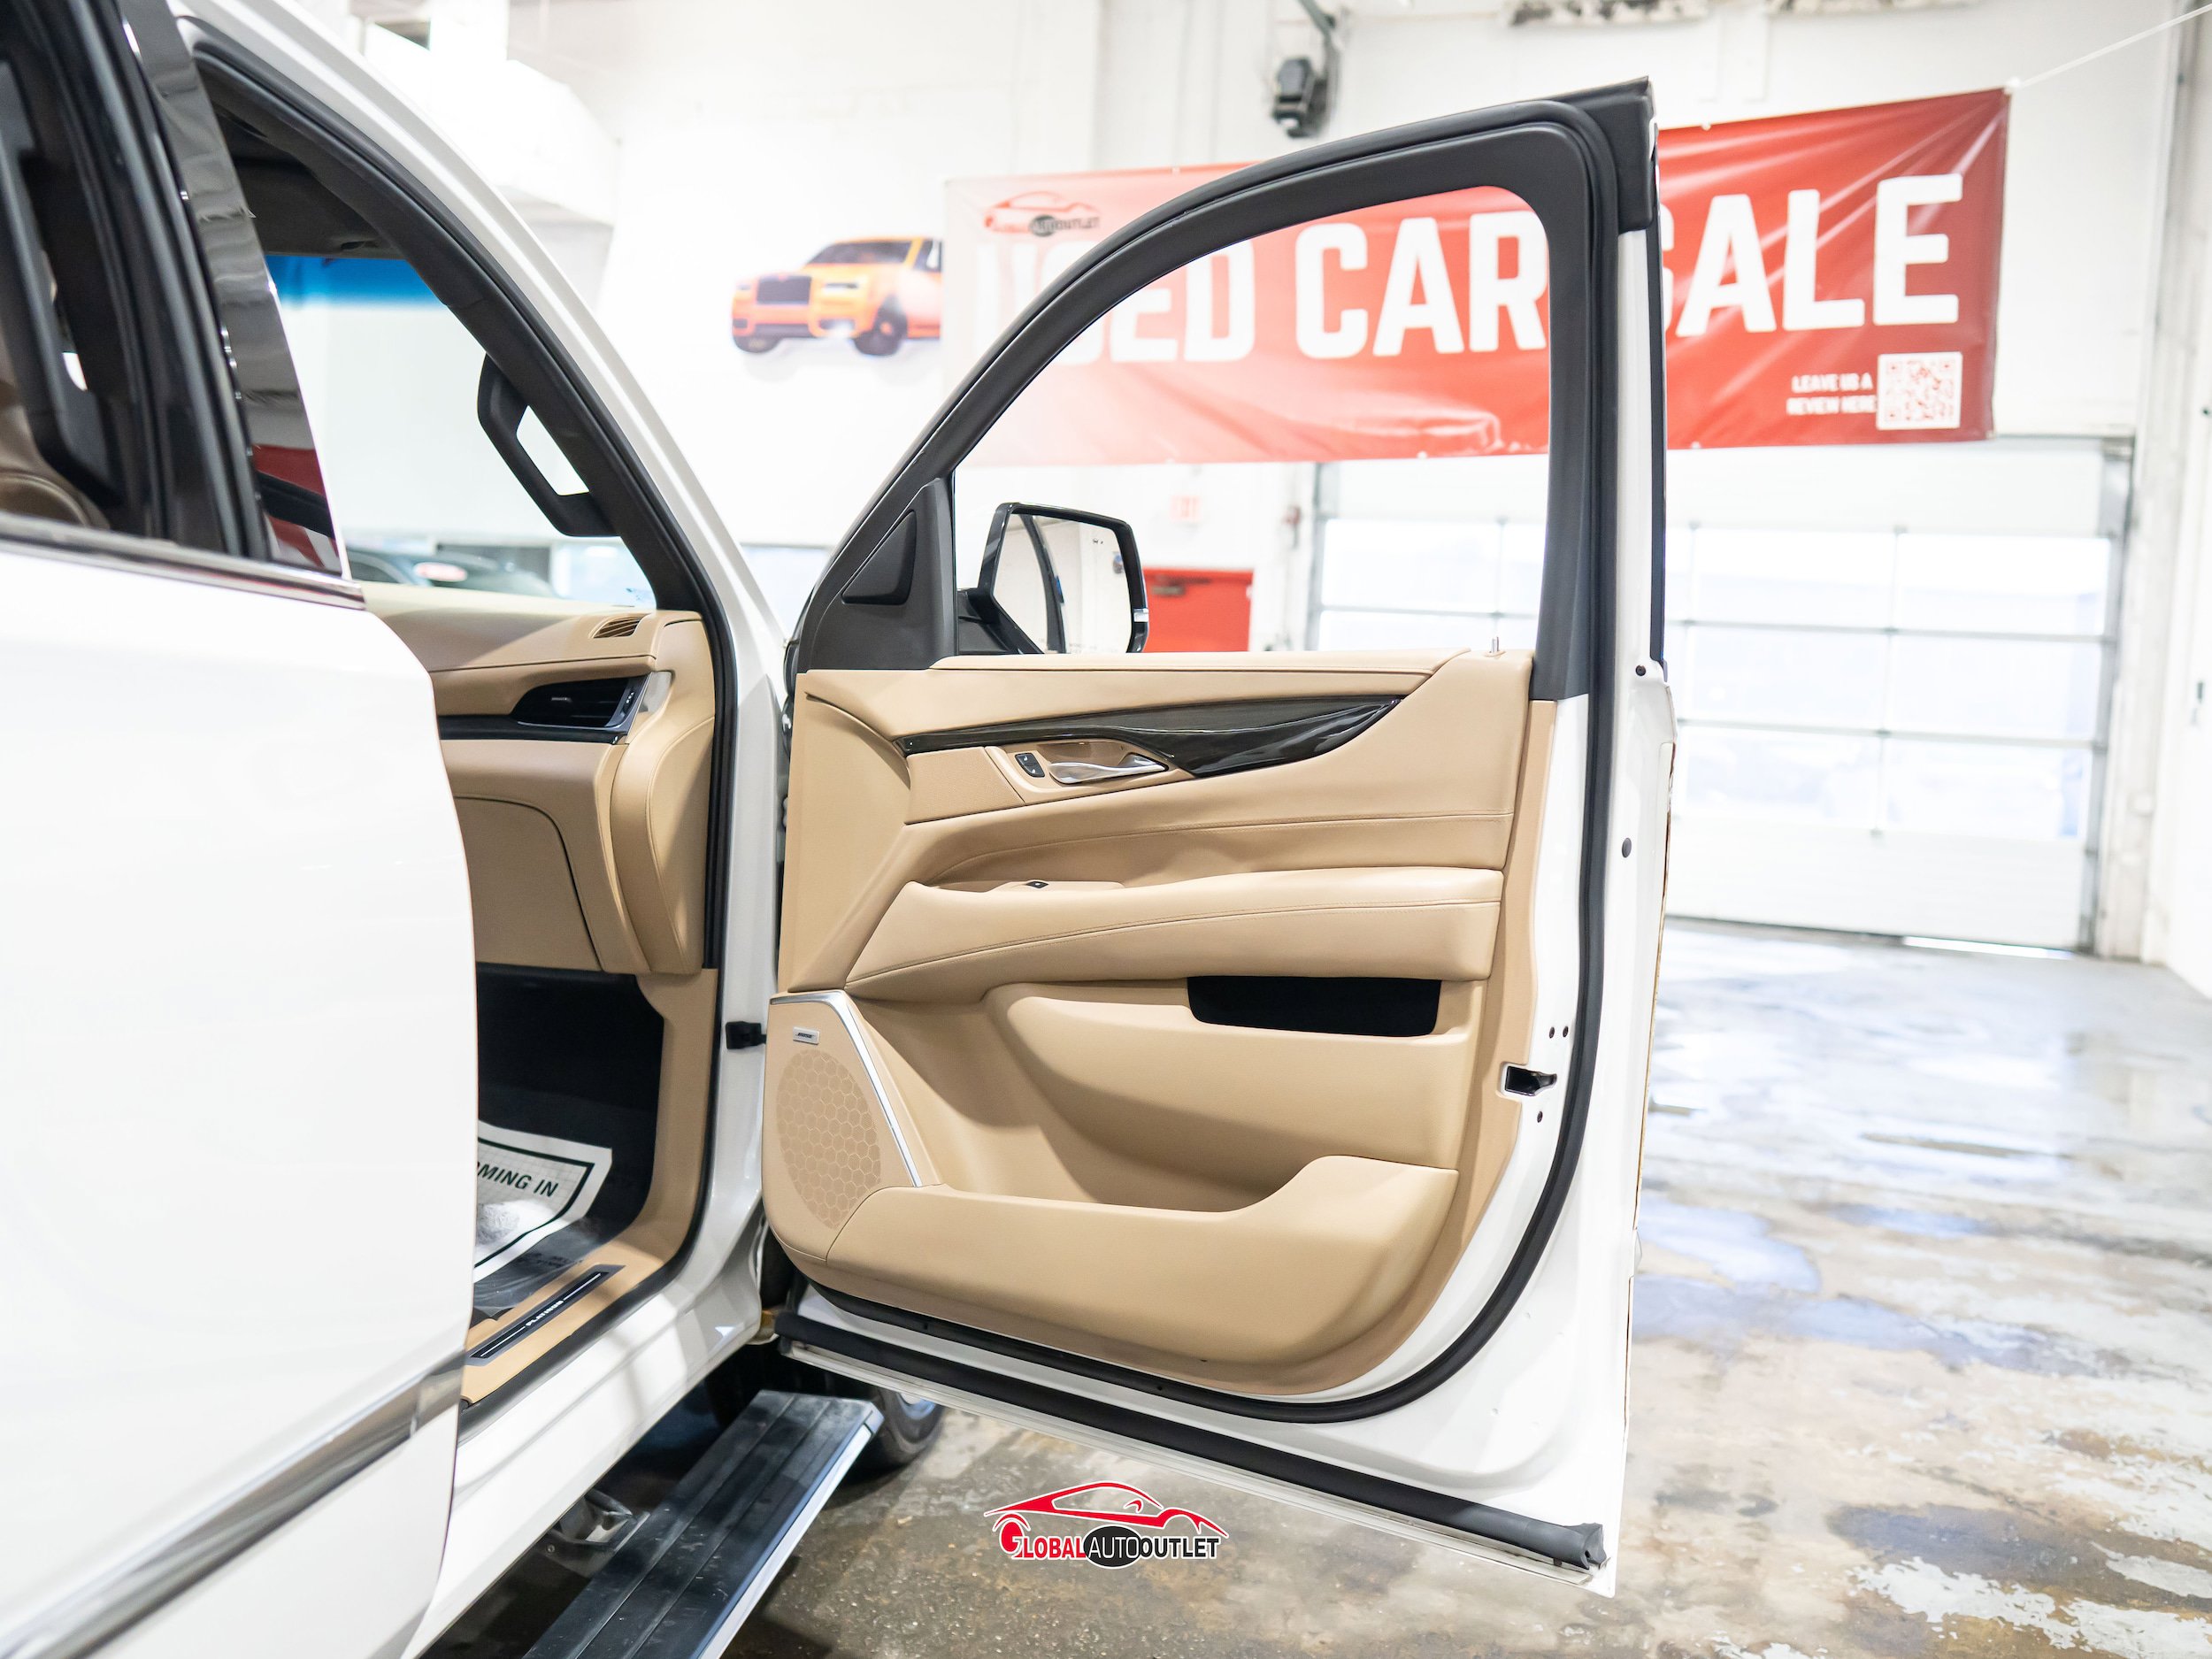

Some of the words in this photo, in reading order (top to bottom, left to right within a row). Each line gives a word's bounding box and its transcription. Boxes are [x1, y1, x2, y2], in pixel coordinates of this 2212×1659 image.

[1294, 211, 1548, 359] CAR
[1659, 173, 1962, 337] ALE
[478, 1162, 532, 1189] MING
[534, 1179, 559, 1197] IN
